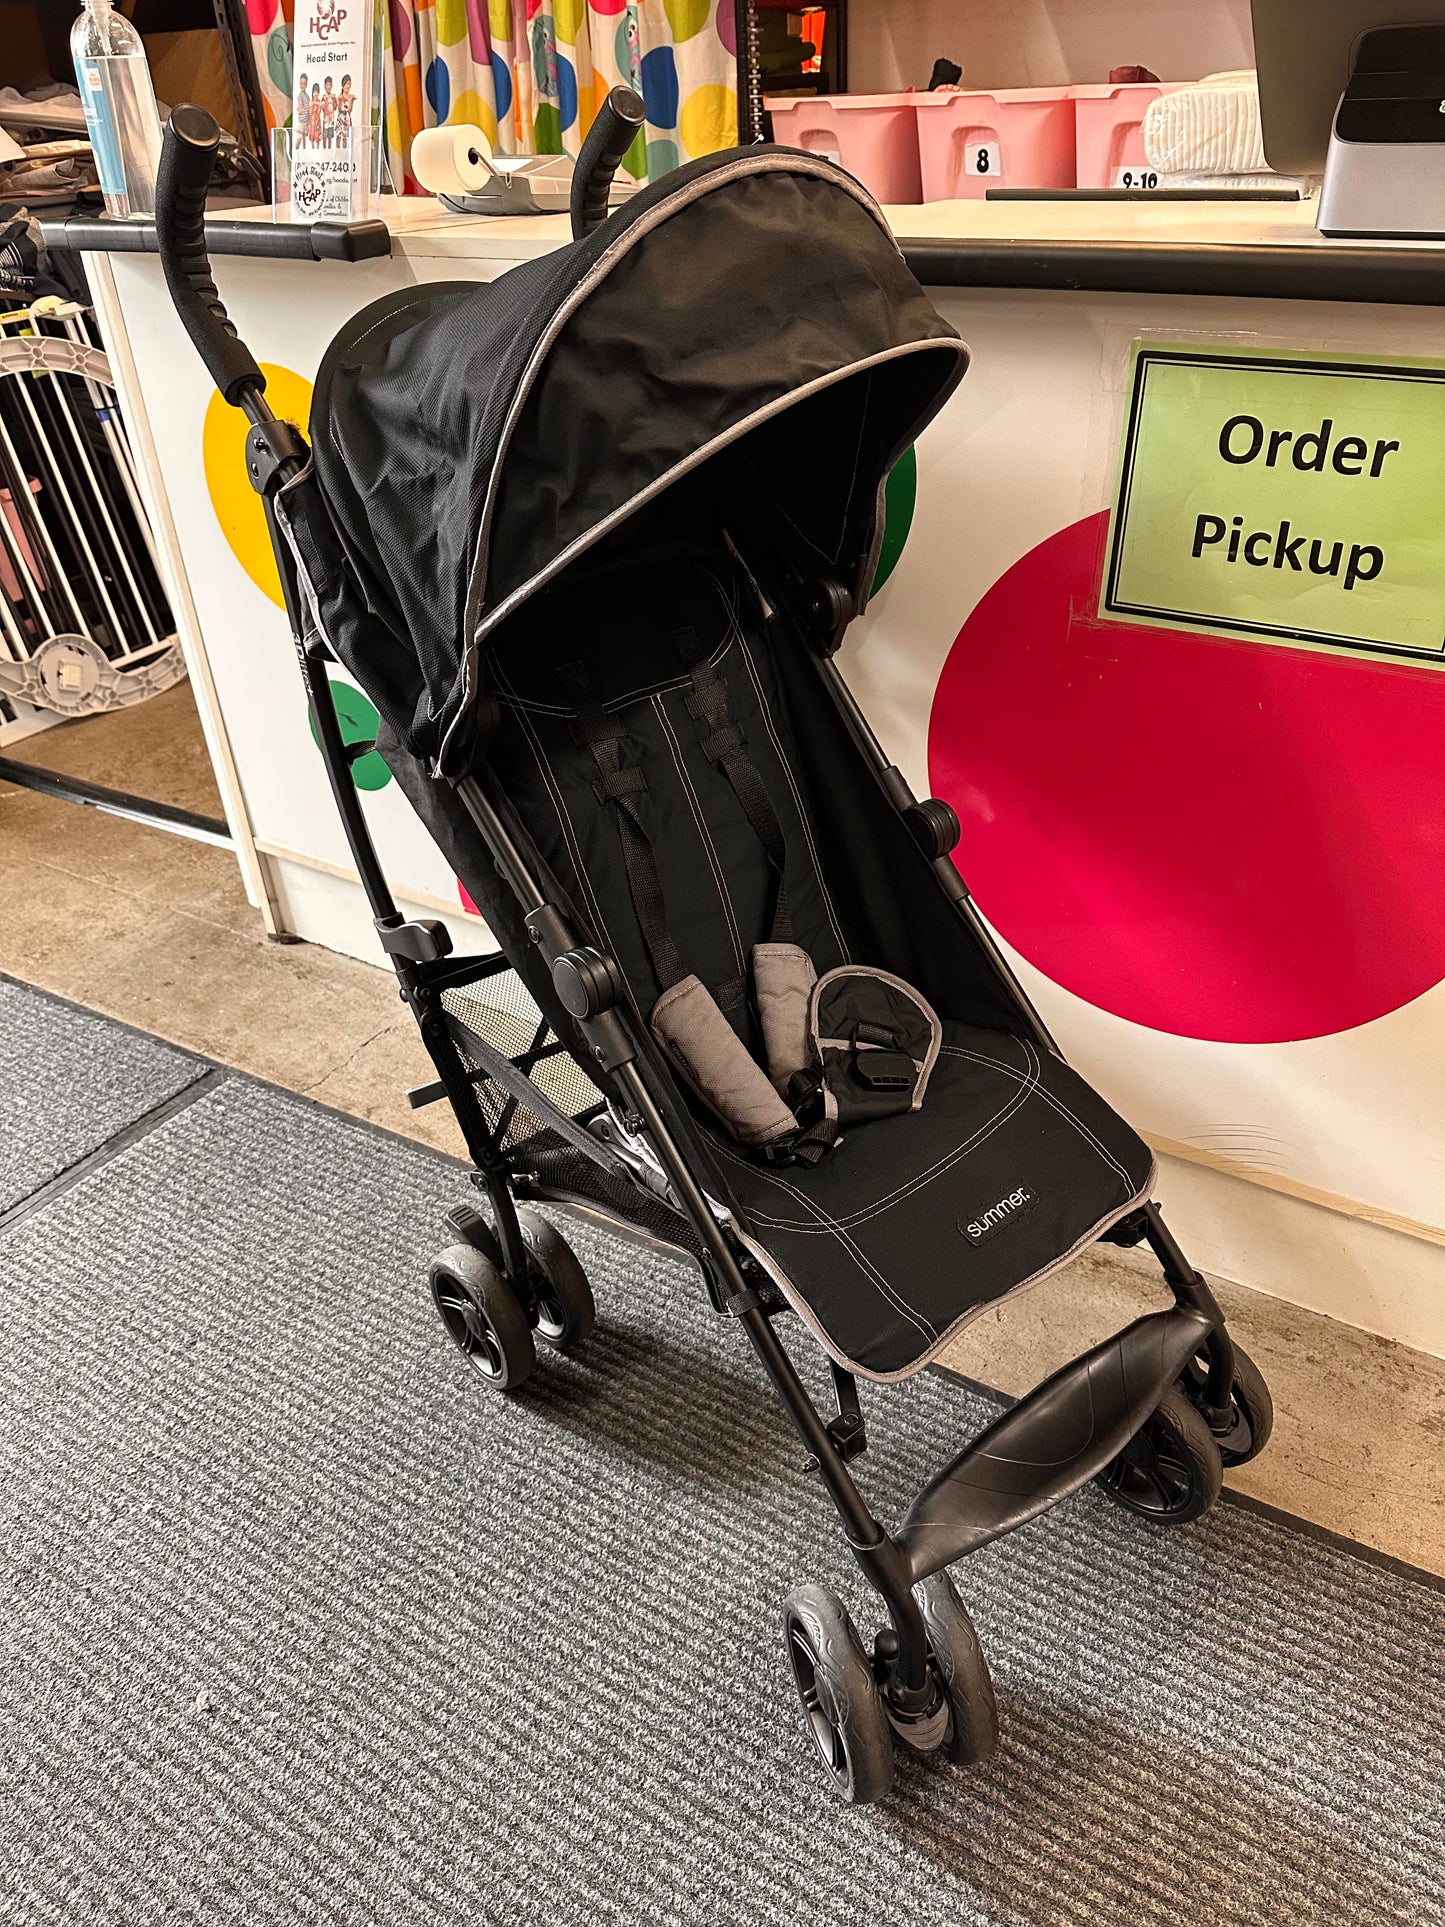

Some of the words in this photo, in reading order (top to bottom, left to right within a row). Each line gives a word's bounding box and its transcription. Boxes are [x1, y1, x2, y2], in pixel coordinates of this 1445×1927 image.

[310, 9, 347, 40] HCAP
[306, 52, 326, 63] Head
[327, 52, 348, 62] Start
[976, 149, 989, 173] 8
[1122, 172, 1158, 188] 9-10
[298, 189, 321, 206] HCAP
[1218, 415, 1400, 478] Order
[1191, 514, 1384, 591] Pickup
